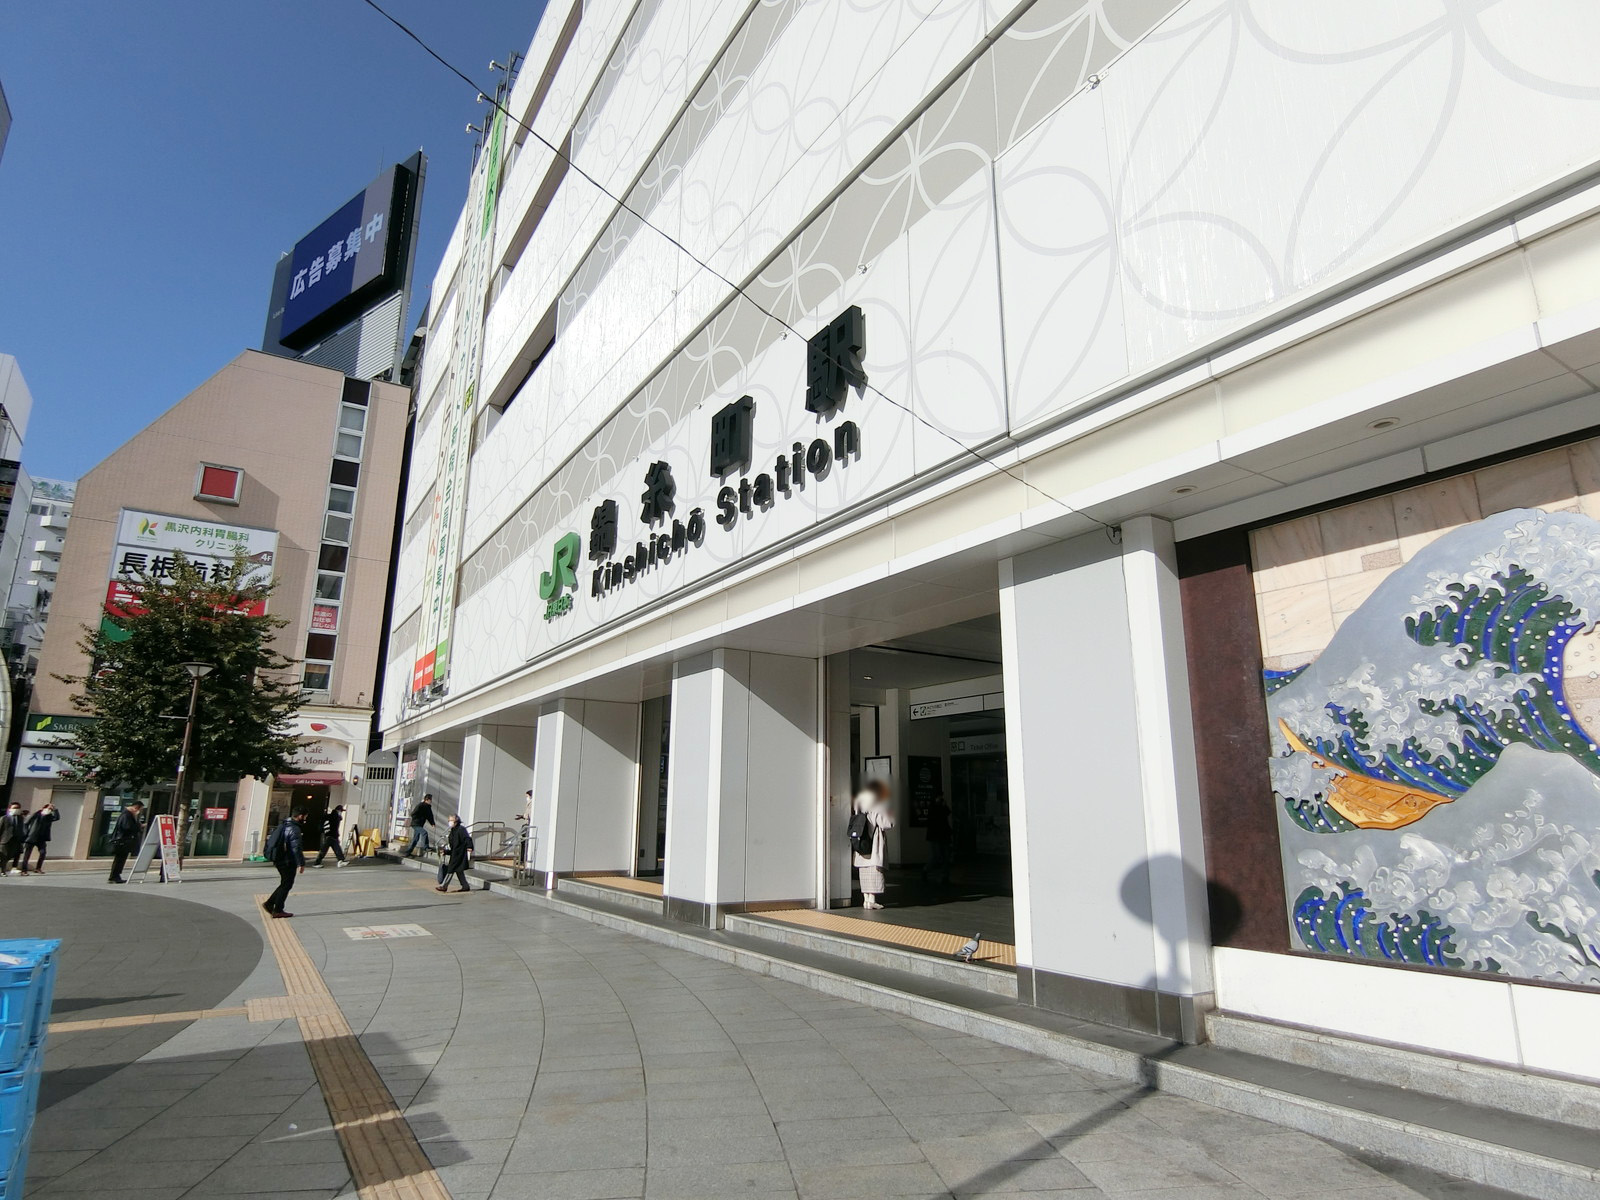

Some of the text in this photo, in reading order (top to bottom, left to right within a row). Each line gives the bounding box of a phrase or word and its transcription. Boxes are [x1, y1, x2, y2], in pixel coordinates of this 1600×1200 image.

[290, 213, 383, 300] 広告募集中
[589, 305, 866, 562] 錦糸町駅
[591, 420, 859, 599] Kinshichō Station
[165, 521, 249, 542] 黒沢内科胃腸科
[195, 539, 249, 553] クリニック
[261, 553, 272, 562] 4F
[540, 532, 580, 601] JR
[30, 752, 53, 761] 入口
[303, 746, 323, 754] Café
[303, 756, 333, 765] Monde
